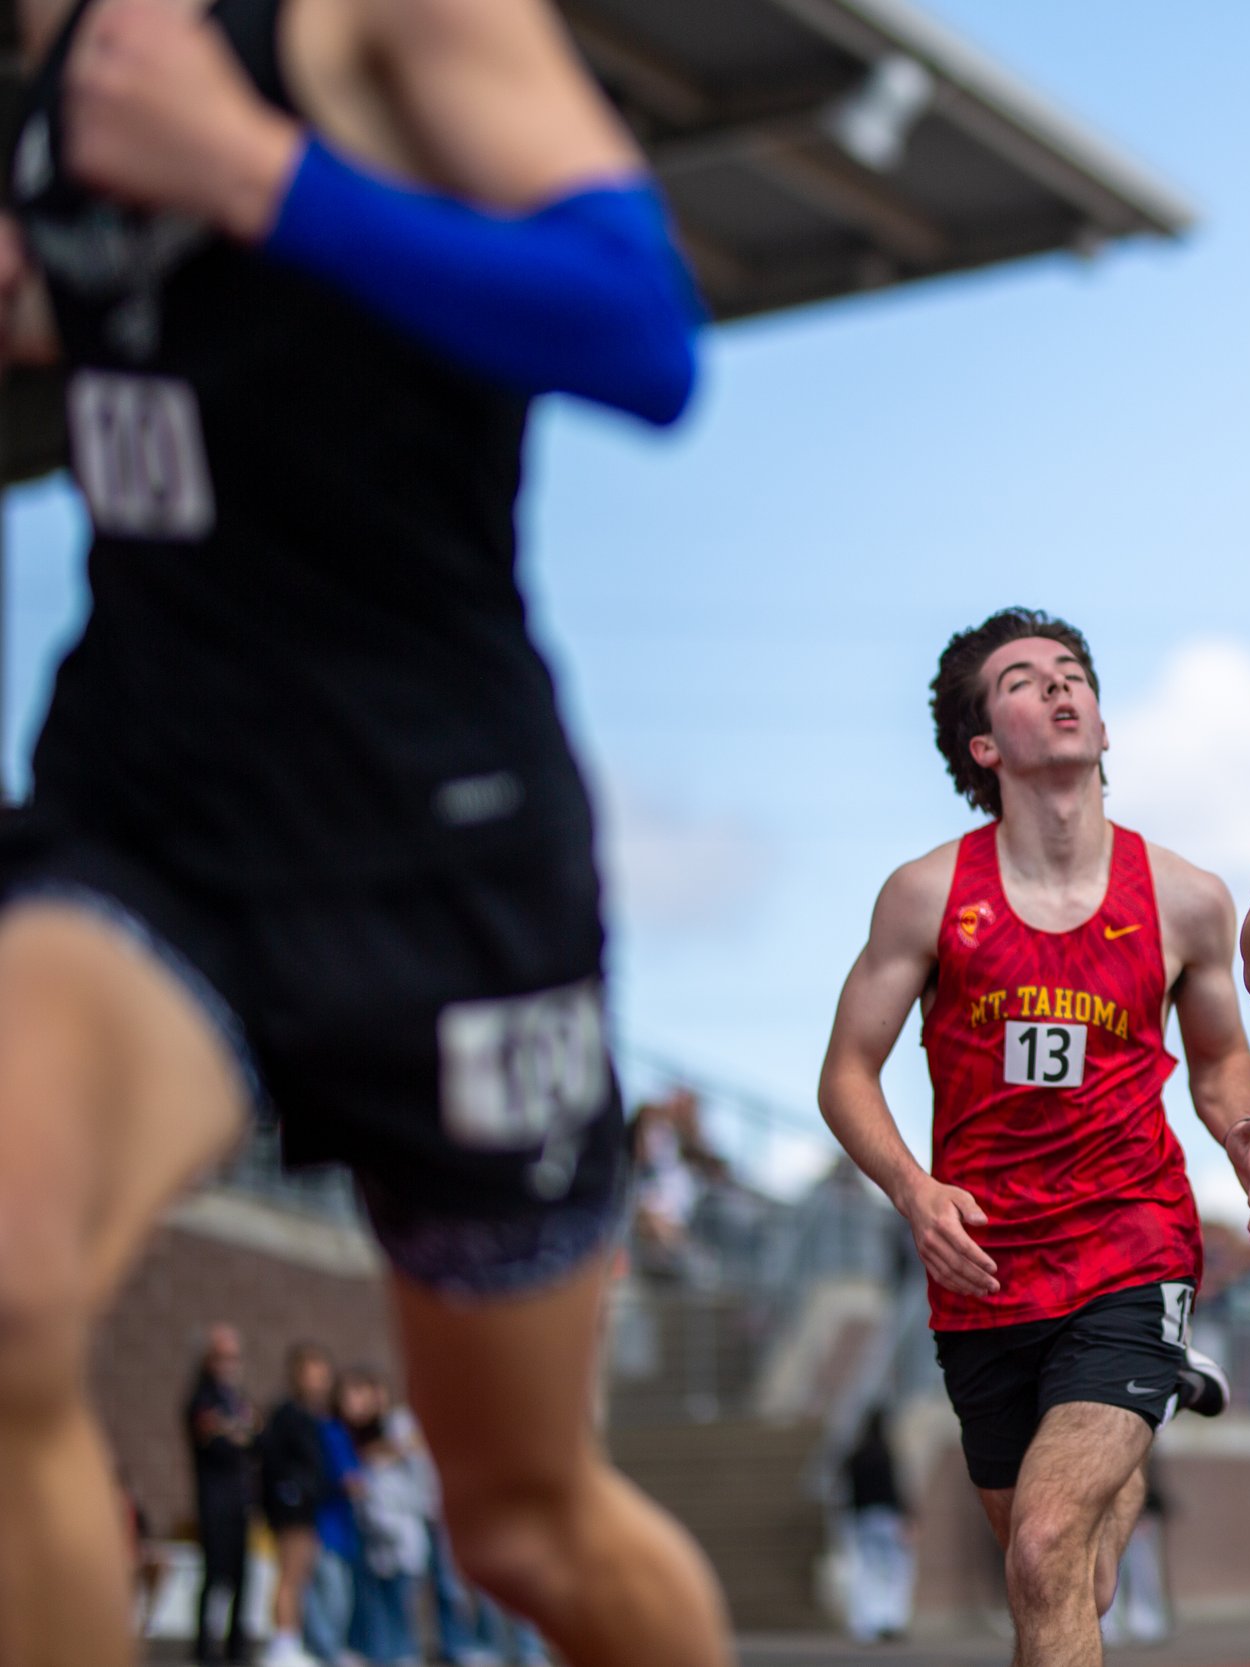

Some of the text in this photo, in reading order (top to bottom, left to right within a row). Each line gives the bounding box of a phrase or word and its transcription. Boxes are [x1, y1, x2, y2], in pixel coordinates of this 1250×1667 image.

[970, 986, 1129, 1041] MT. TAHOMA
[1017, 1026, 1072, 1083] 13
